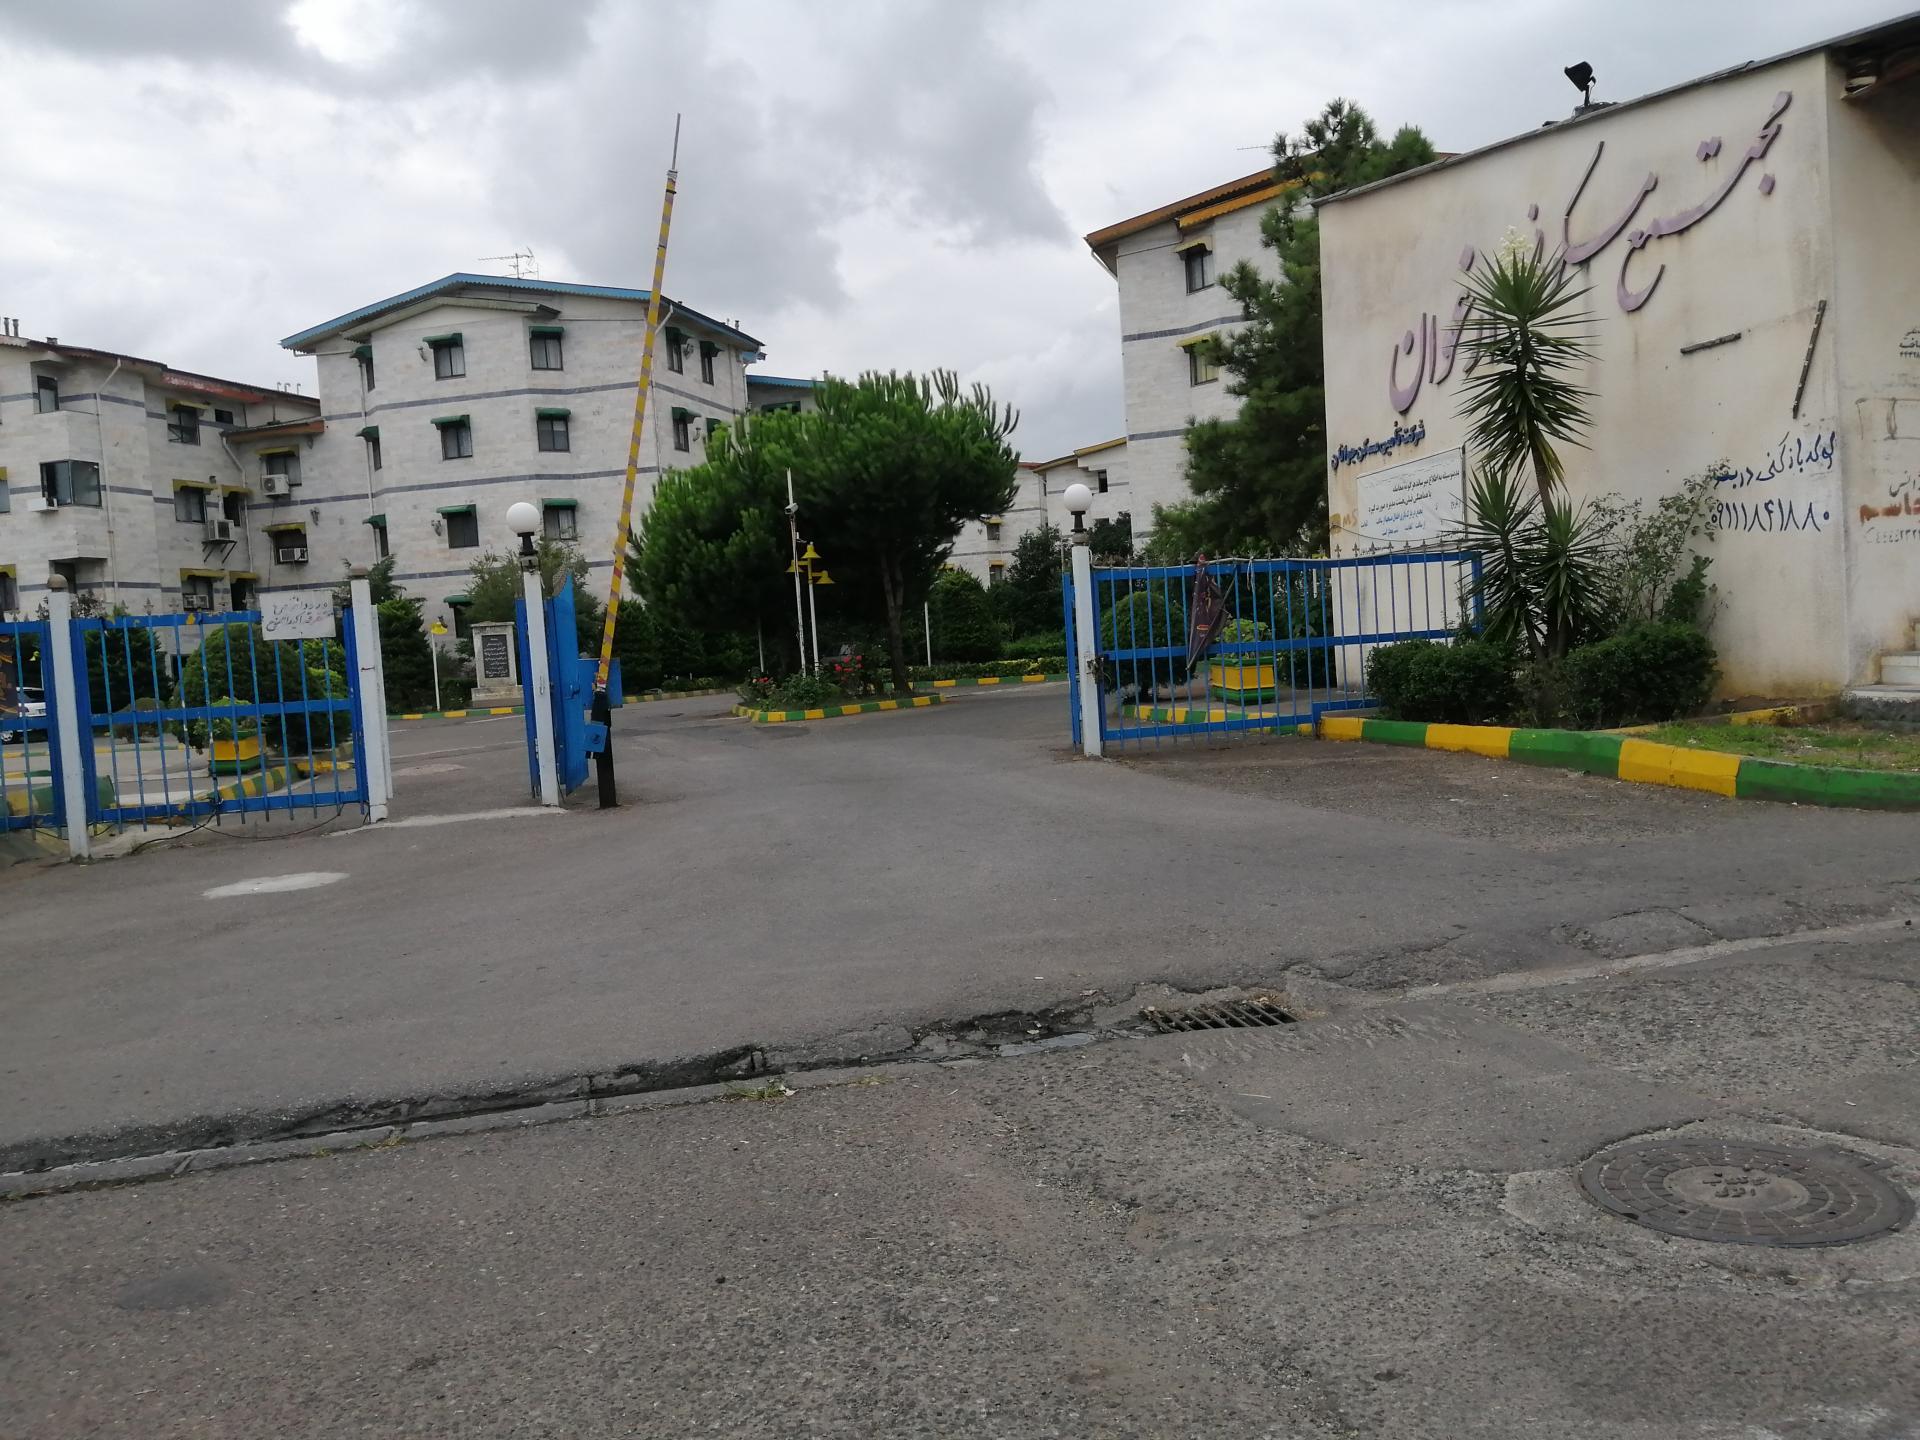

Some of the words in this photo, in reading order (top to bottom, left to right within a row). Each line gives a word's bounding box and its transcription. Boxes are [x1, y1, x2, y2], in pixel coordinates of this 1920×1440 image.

[1617, 91, 1793, 313] مجتمع
[1522, 140, 1660, 308] مسکون
[1402, 419, 1426, 448] شرکت
[1331, 443, 1358, 471] جوانان
[1357, 437, 1381, 463] مسکن
